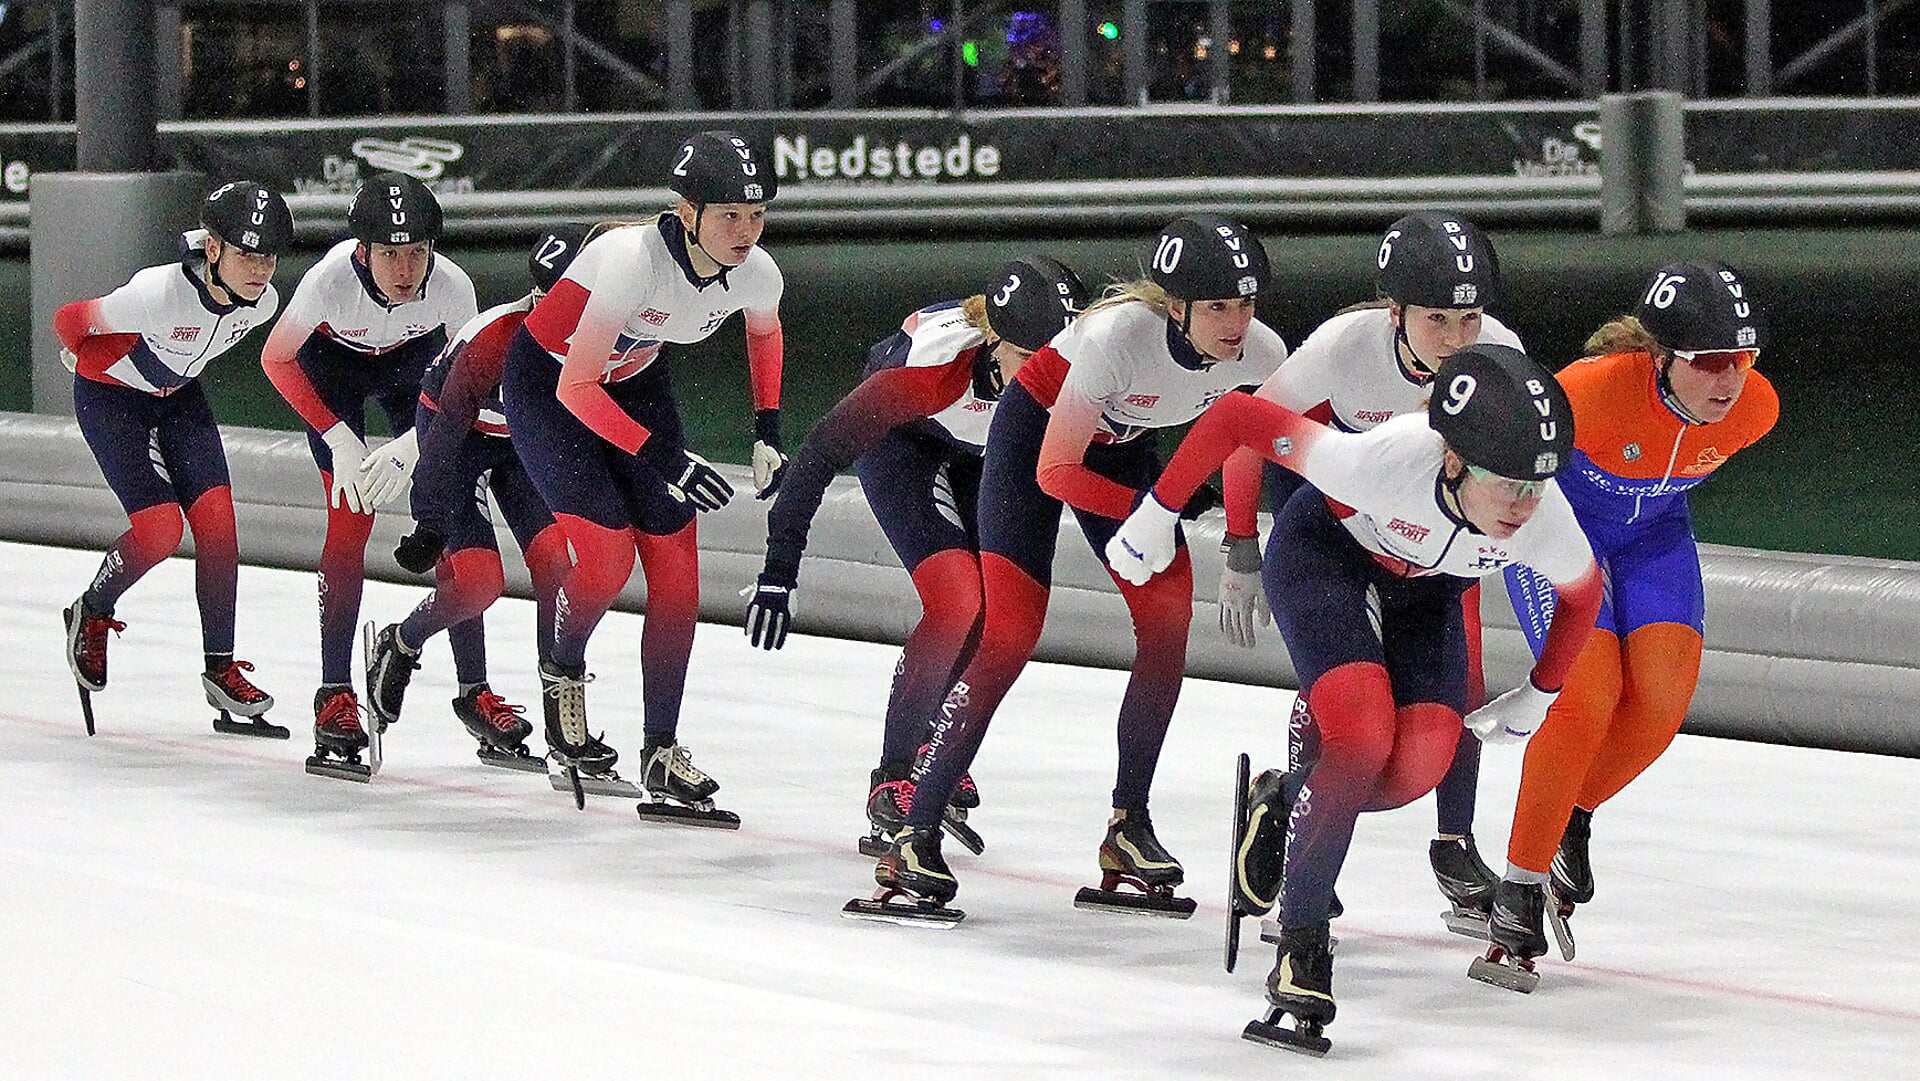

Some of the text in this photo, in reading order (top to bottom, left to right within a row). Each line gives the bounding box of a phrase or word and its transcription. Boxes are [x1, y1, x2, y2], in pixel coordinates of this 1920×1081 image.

[0, 152, 30, 193] e
[673, 145, 695, 177] 2
[730, 137, 757, 177] BVU
[773, 134, 1000, 178] Nedstede
[208, 183, 235, 201] 8
[250, 189, 269, 226] BVU
[388, 186, 407, 226] BVU
[534, 234, 568, 270] 12
[1152, 235, 1184, 274] 10
[1215, 225, 1250, 269] BVU
[1376, 230, 1402, 270] 6
[1442, 220, 1475, 273] BVU
[993, 274, 1022, 307] 3
[1644, 271, 1688, 309] 16
[1718, 270, 1751, 318] BVU
[1441, 374, 1478, 416] 9
[1525, 378, 1558, 441] BVU
[1386, 520, 1429, 544] SPORT
[1290, 741, 1304, 774] Tech
